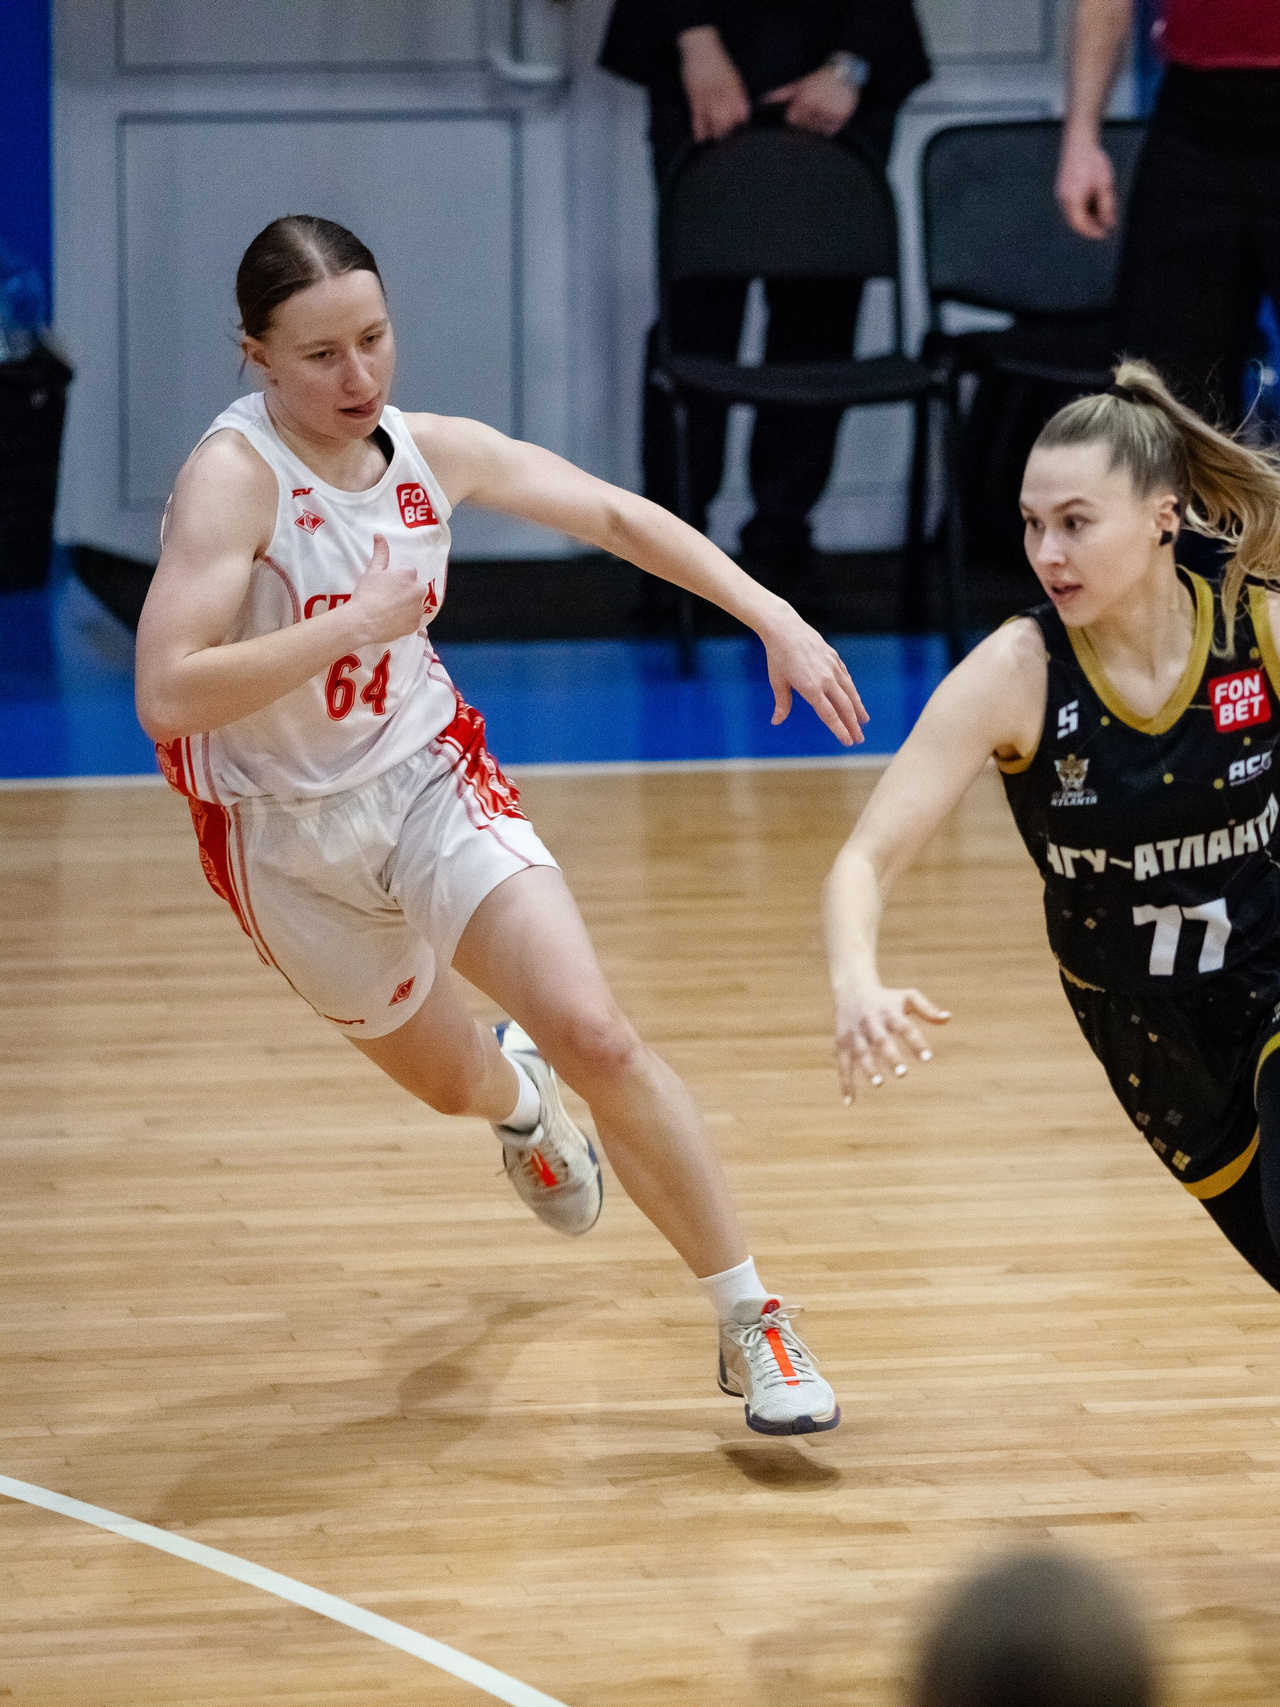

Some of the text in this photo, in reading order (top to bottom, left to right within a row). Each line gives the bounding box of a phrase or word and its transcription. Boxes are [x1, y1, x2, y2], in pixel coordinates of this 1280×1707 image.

[400, 488, 428, 506] FO
[325, 650, 391, 721] 64
[1214, 674, 1260, 705] FON
[1219, 694, 1265, 726] BET
[1132, 897, 1232, 976] 77
